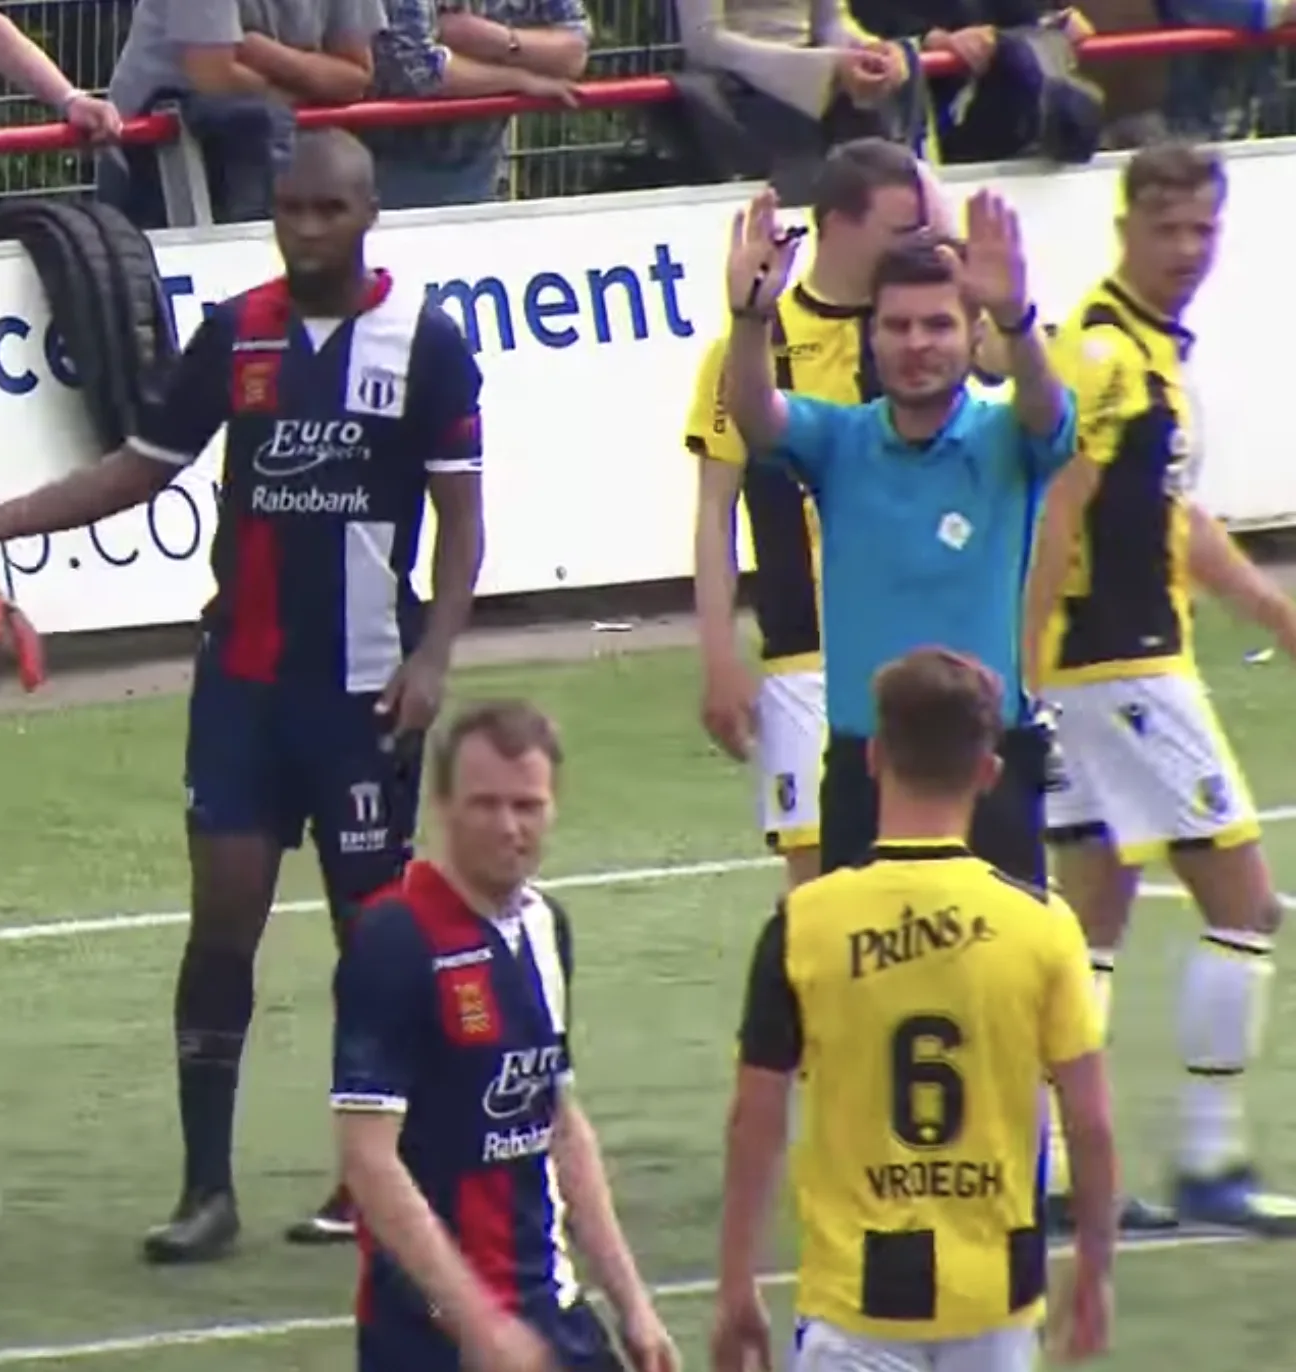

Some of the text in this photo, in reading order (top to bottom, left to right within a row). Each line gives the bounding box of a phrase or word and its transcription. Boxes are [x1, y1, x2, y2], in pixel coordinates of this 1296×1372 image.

[251, 485, 371, 513] Rabobank
[890, 1014, 963, 1148] 6
[865, 1161, 1004, 1200] VROEGH
